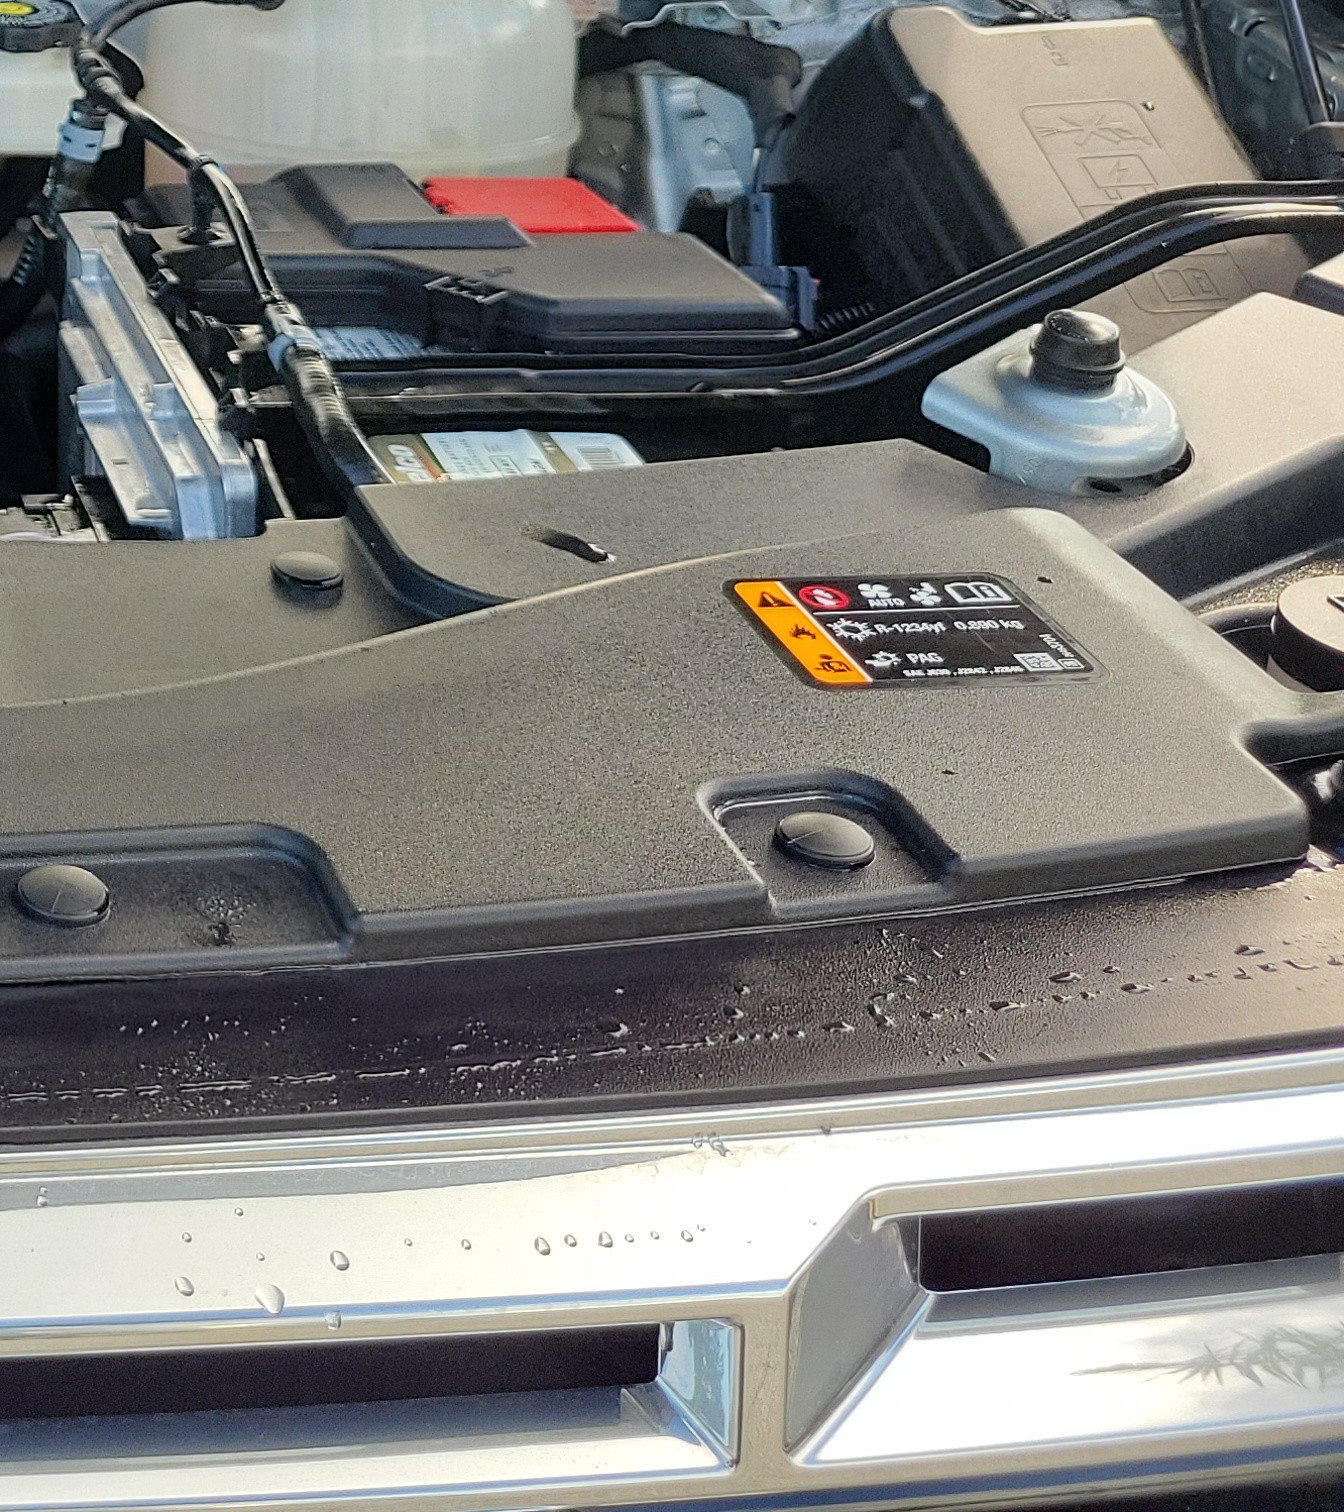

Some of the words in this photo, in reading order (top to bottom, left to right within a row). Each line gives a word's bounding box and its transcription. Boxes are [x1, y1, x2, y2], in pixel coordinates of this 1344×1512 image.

[867, 597, 906, 608] AUTO
[998, 619, 1026, 630] kg
[905, 652, 944, 664] PAG
